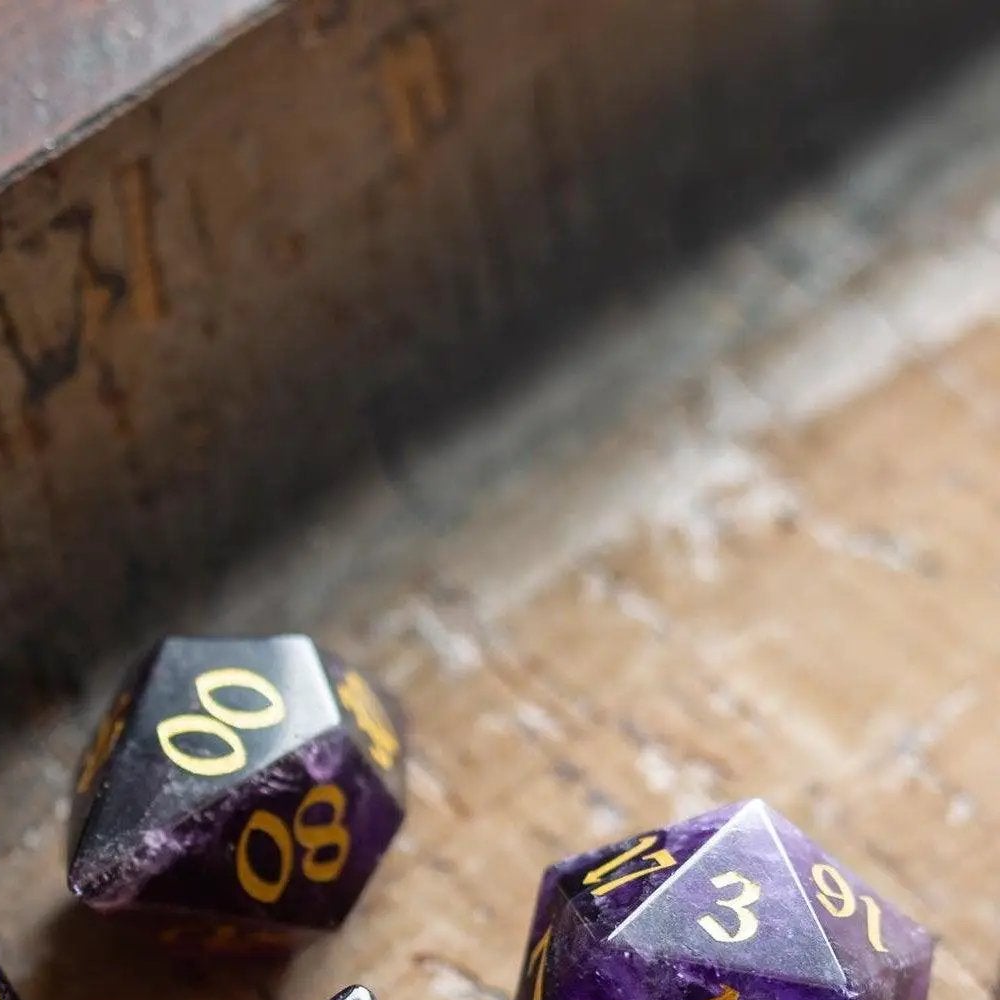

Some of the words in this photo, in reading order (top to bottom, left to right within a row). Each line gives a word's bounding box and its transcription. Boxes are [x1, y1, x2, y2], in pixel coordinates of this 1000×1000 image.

[156, 667, 285, 776] 00
[237, 784, 351, 903] 80
[582, 836, 677, 897] 17
[699, 871, 761, 943] 3
